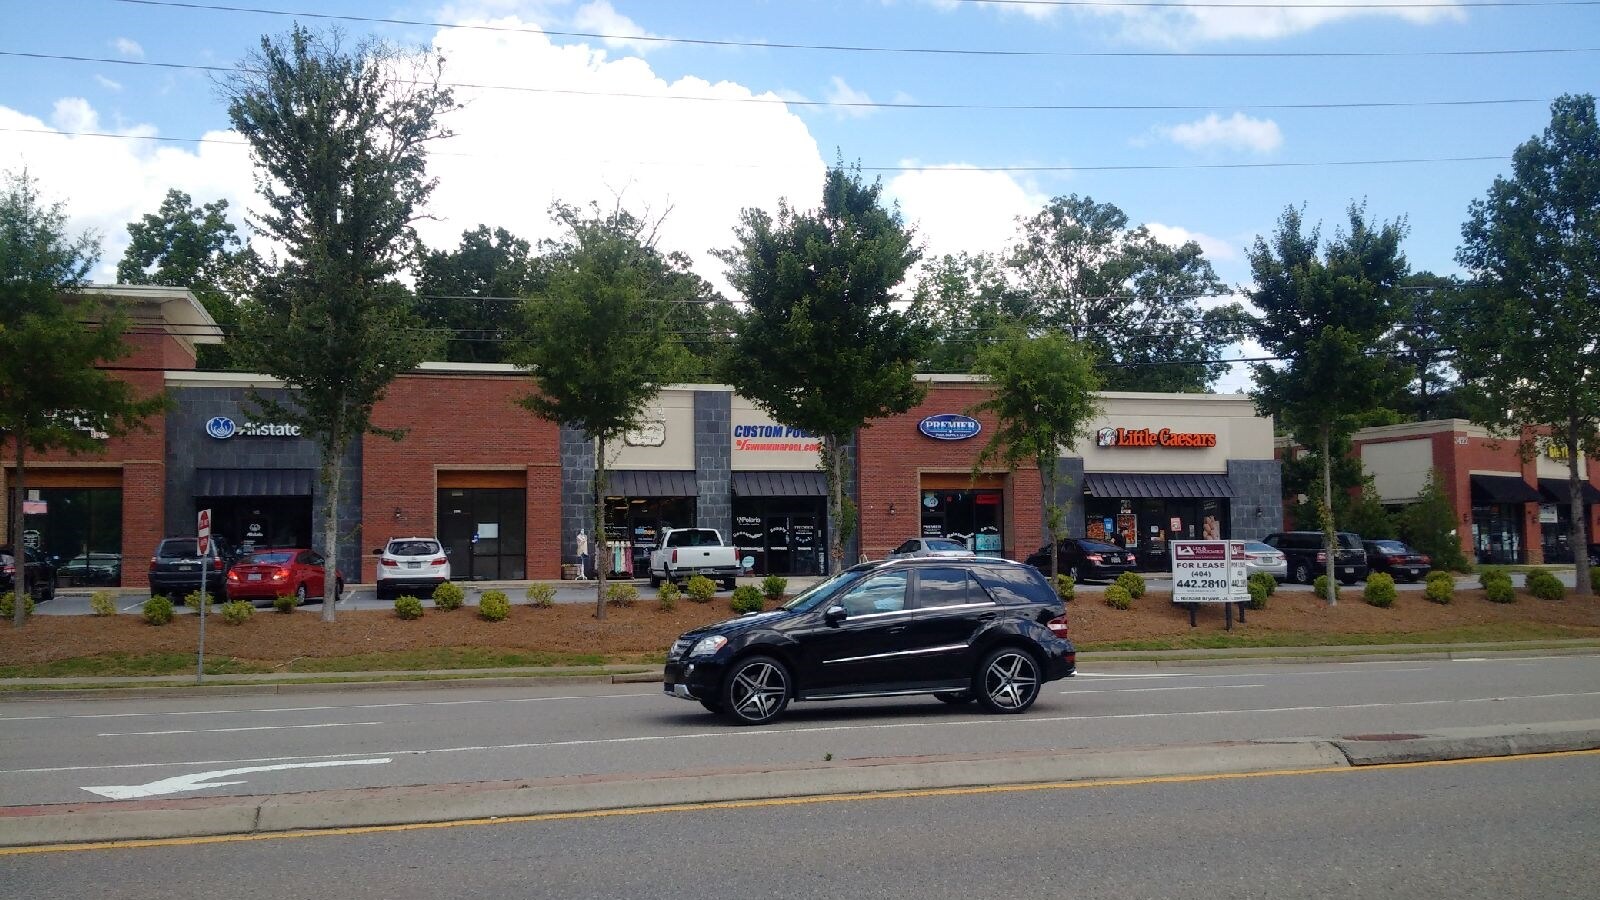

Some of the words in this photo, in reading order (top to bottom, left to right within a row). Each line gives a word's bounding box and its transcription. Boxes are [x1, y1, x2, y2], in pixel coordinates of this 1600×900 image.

[925, 420, 975, 428] PREMIER
[734, 425, 783, 438] CUSTOM
[1115, 428, 1158, 446] Little
[1158, 428, 1217, 447] Caesars
[1176, 579, 1226, 588] 442.2810
